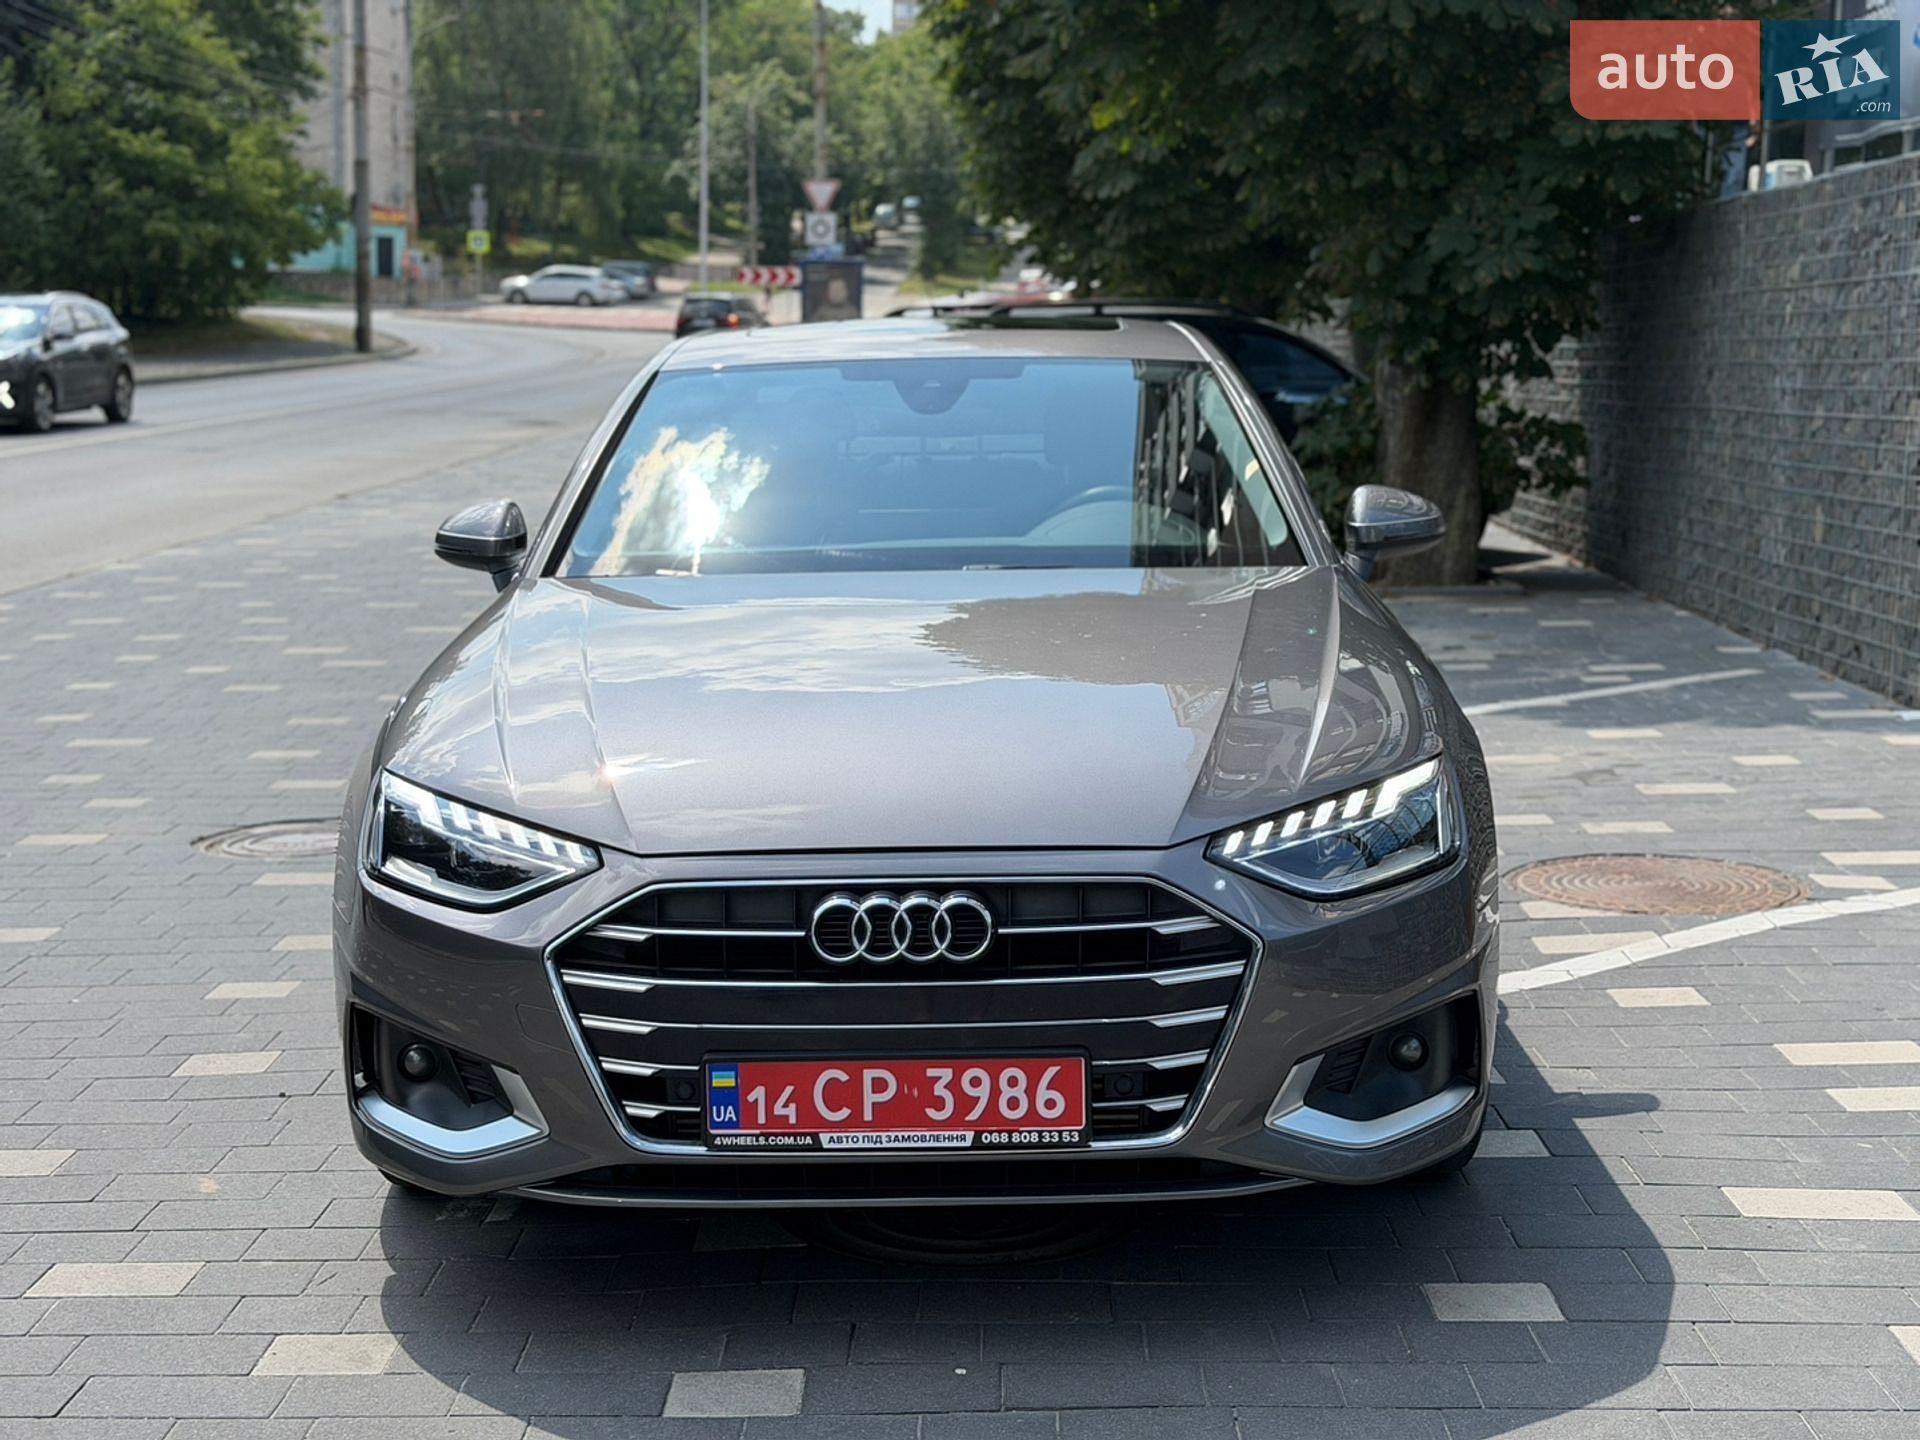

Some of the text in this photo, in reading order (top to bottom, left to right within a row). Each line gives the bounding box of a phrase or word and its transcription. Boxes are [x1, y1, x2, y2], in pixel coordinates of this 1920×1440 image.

[746, 1065, 1066, 1125] 14 CP 3986
[712, 1105, 737, 1122] UA
[714, 1135, 813, 1146] 4WHEELS.COM.UA
[827, 1132, 967, 1146] АВТО ПІД ЗАМОВЛЕННЯ
[981, 1131, 1080, 1144] 068 808 33 53
